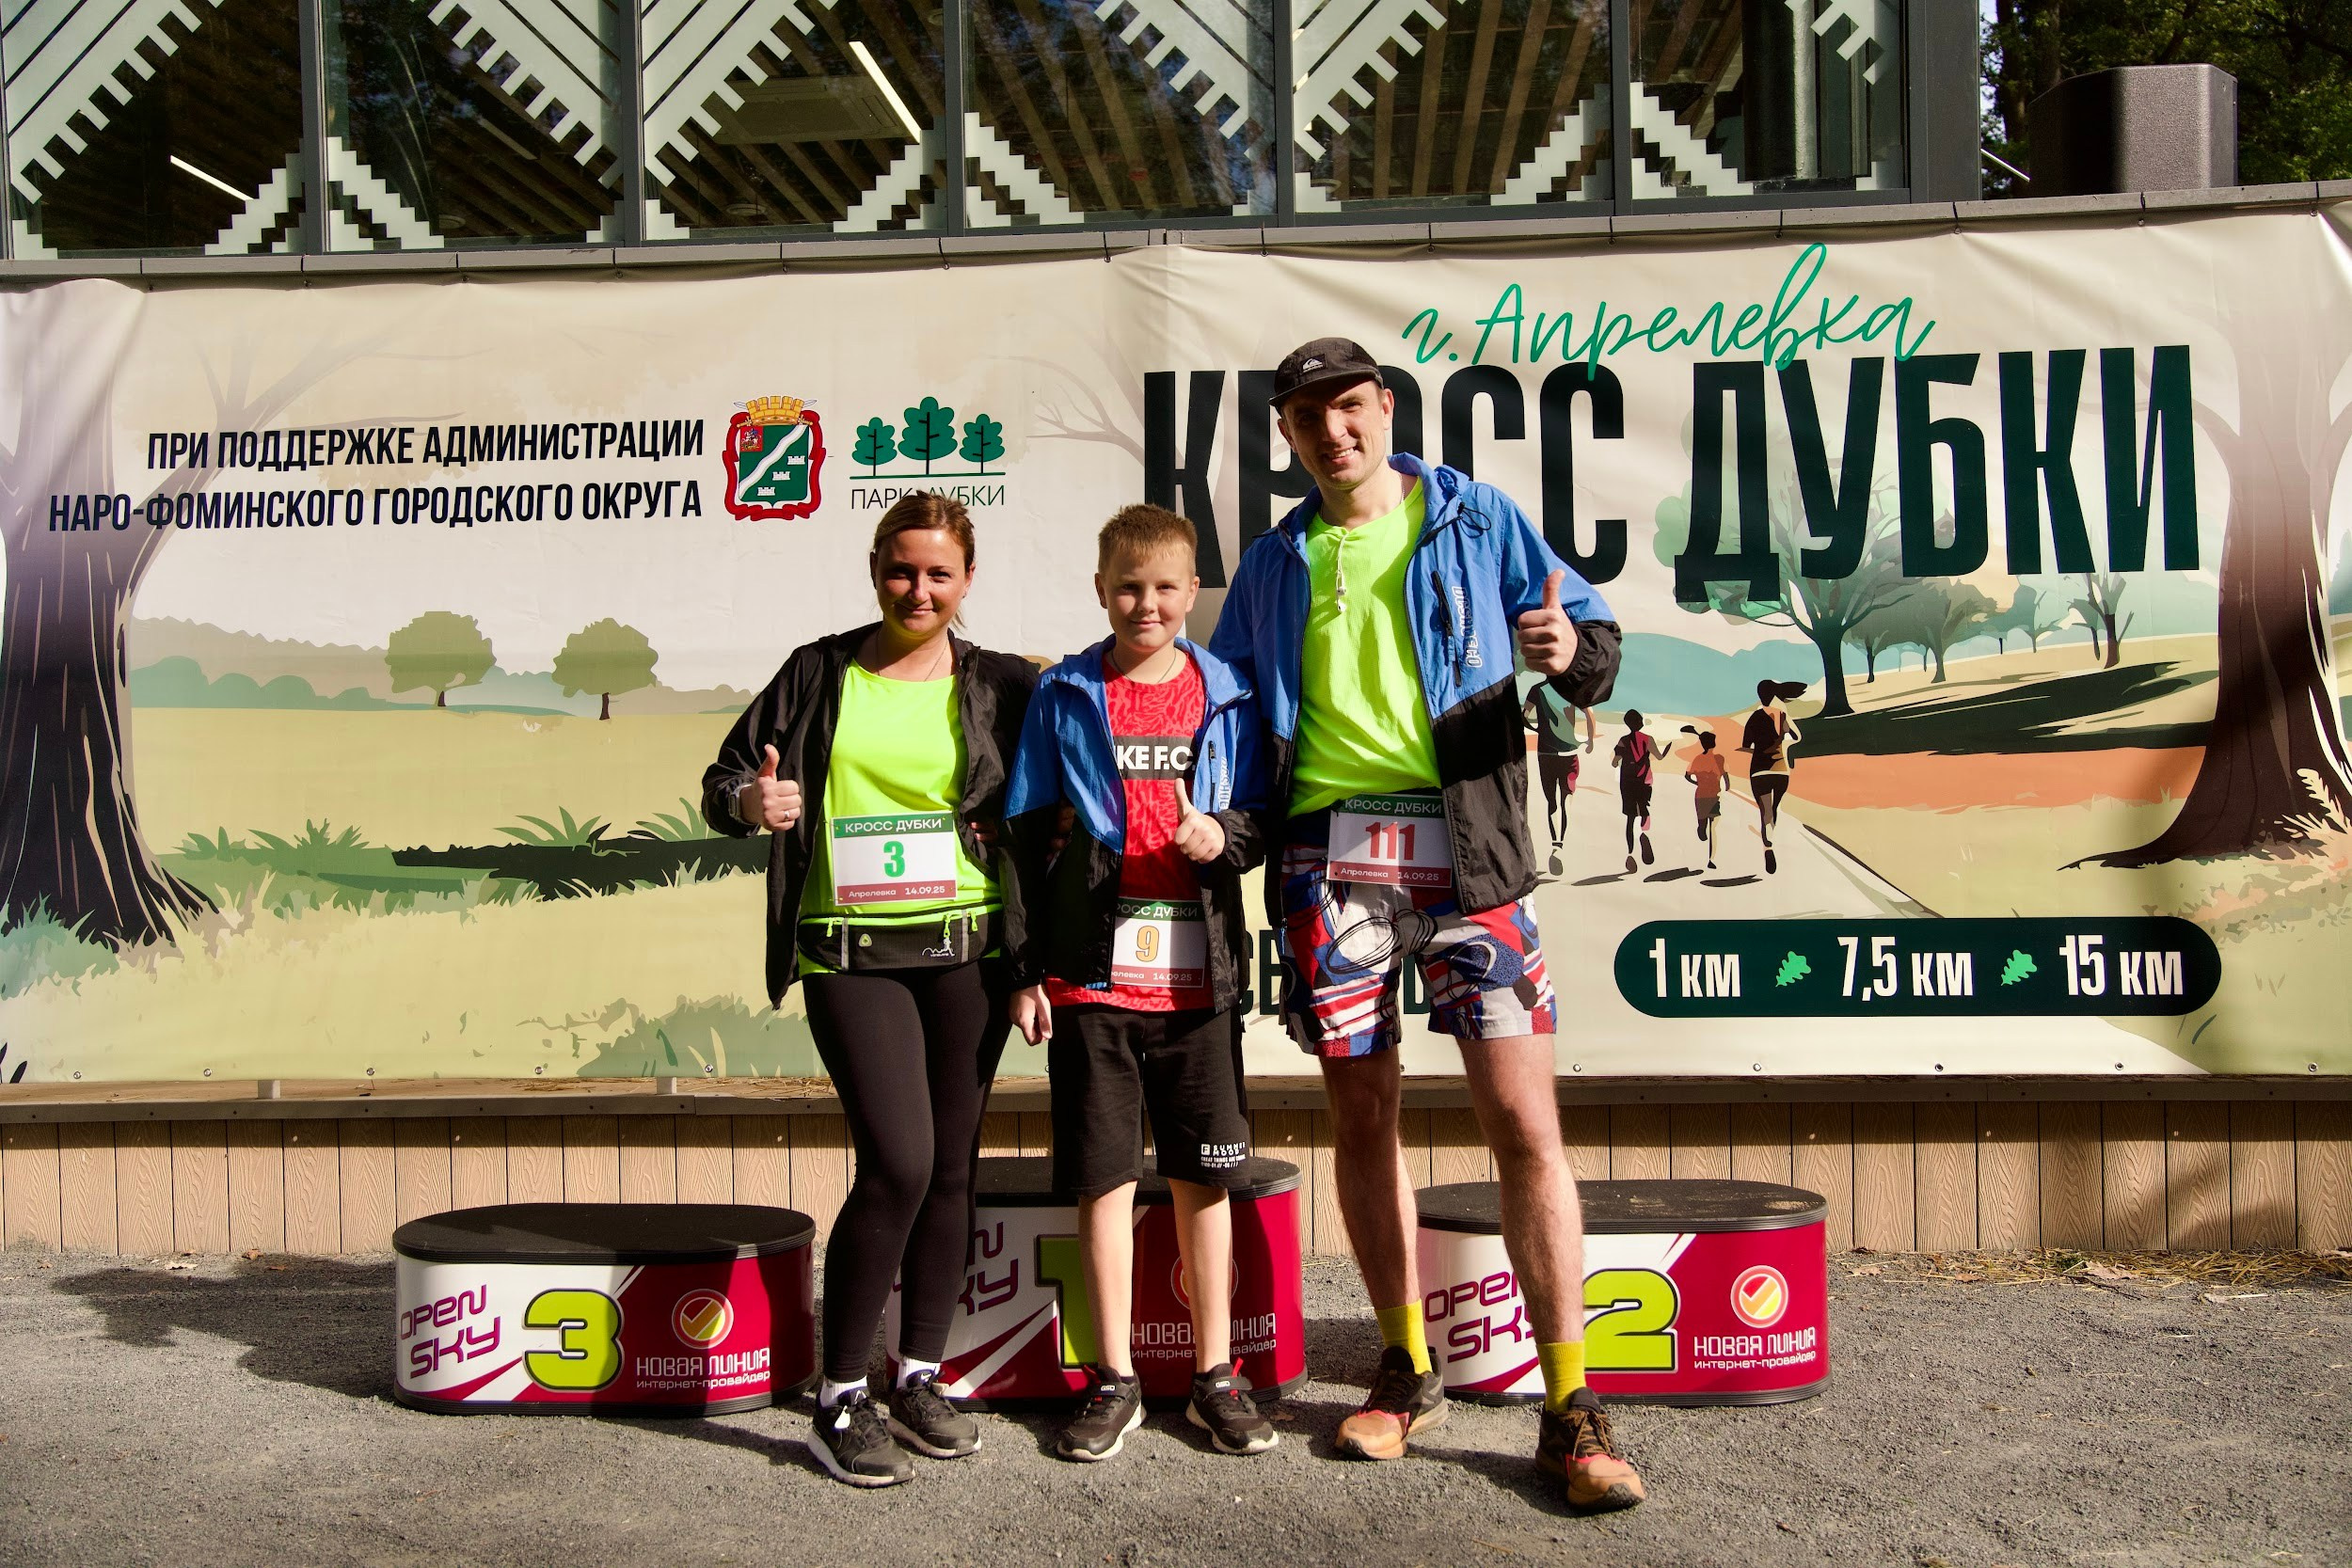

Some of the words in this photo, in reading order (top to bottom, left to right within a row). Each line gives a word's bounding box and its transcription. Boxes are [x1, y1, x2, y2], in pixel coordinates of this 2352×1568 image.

[1471, 243, 1935, 381] Апрелевка
[147, 433, 209, 469] ПРИ
[217, 427, 414, 472] ПОДДЕРЖКЕ
[422, 419, 705, 467] АДМИНИСТРАЦИИ
[1144, 362, 1627, 589] КРСС
[1675, 345, 2200, 603] ДУБКИ
[49, 487, 364, 532] НАРО-ФОМИНСКОГО
[373, 483, 574, 529] ГОРОДСКОГО
[581, 480, 703, 521] ОКРУГА
[1114, 745, 1149, 769] KE
[1345, 800, 1391, 811] КРОСС
[1394, 802, 1442, 814] ДУБКИ
[845, 821, 893, 833] КРОСС
[896, 818, 942, 832] ДУБКИ
[1366, 821, 1415, 861] 111
[883, 841, 905, 878] 3
[1341, 867, 1389, 878] Апрелевка
[1397, 871, 1439, 880] 14.09.25
[849, 889, 897, 898] Апрелевка
[905, 886, 945, 895] 14.09.25
[1117, 904, 1152, 916] ОСС
[1153, 906, 1198, 919] ДУБКИ
[1136, 926, 1159, 962] 9
[1152, 972, 1192, 981] 14.09.25
[1649, 938, 1667, 998] 1
[1837, 936, 1899, 1002] 7,5
[2059, 934, 2106, 997] 15
[1132, 1322, 1195, 1345] НОВА
[1448, 1304, 1534, 1363] SK
[1584, 1267, 1679, 1374] 2
[522, 1288, 623, 1392] 3
[1694, 1336, 1762, 1356] НОВАЯ
[1767, 1326, 1816, 1354] ЛИНИЯ
[637, 1356, 703, 1376] НОВАЯ
[708, 1347, 771, 1375] ЛИНИЯ
[1694, 1351, 1816, 1370] интернет-провайдер
[637, 1370, 771, 1390] интернет-провайдер
